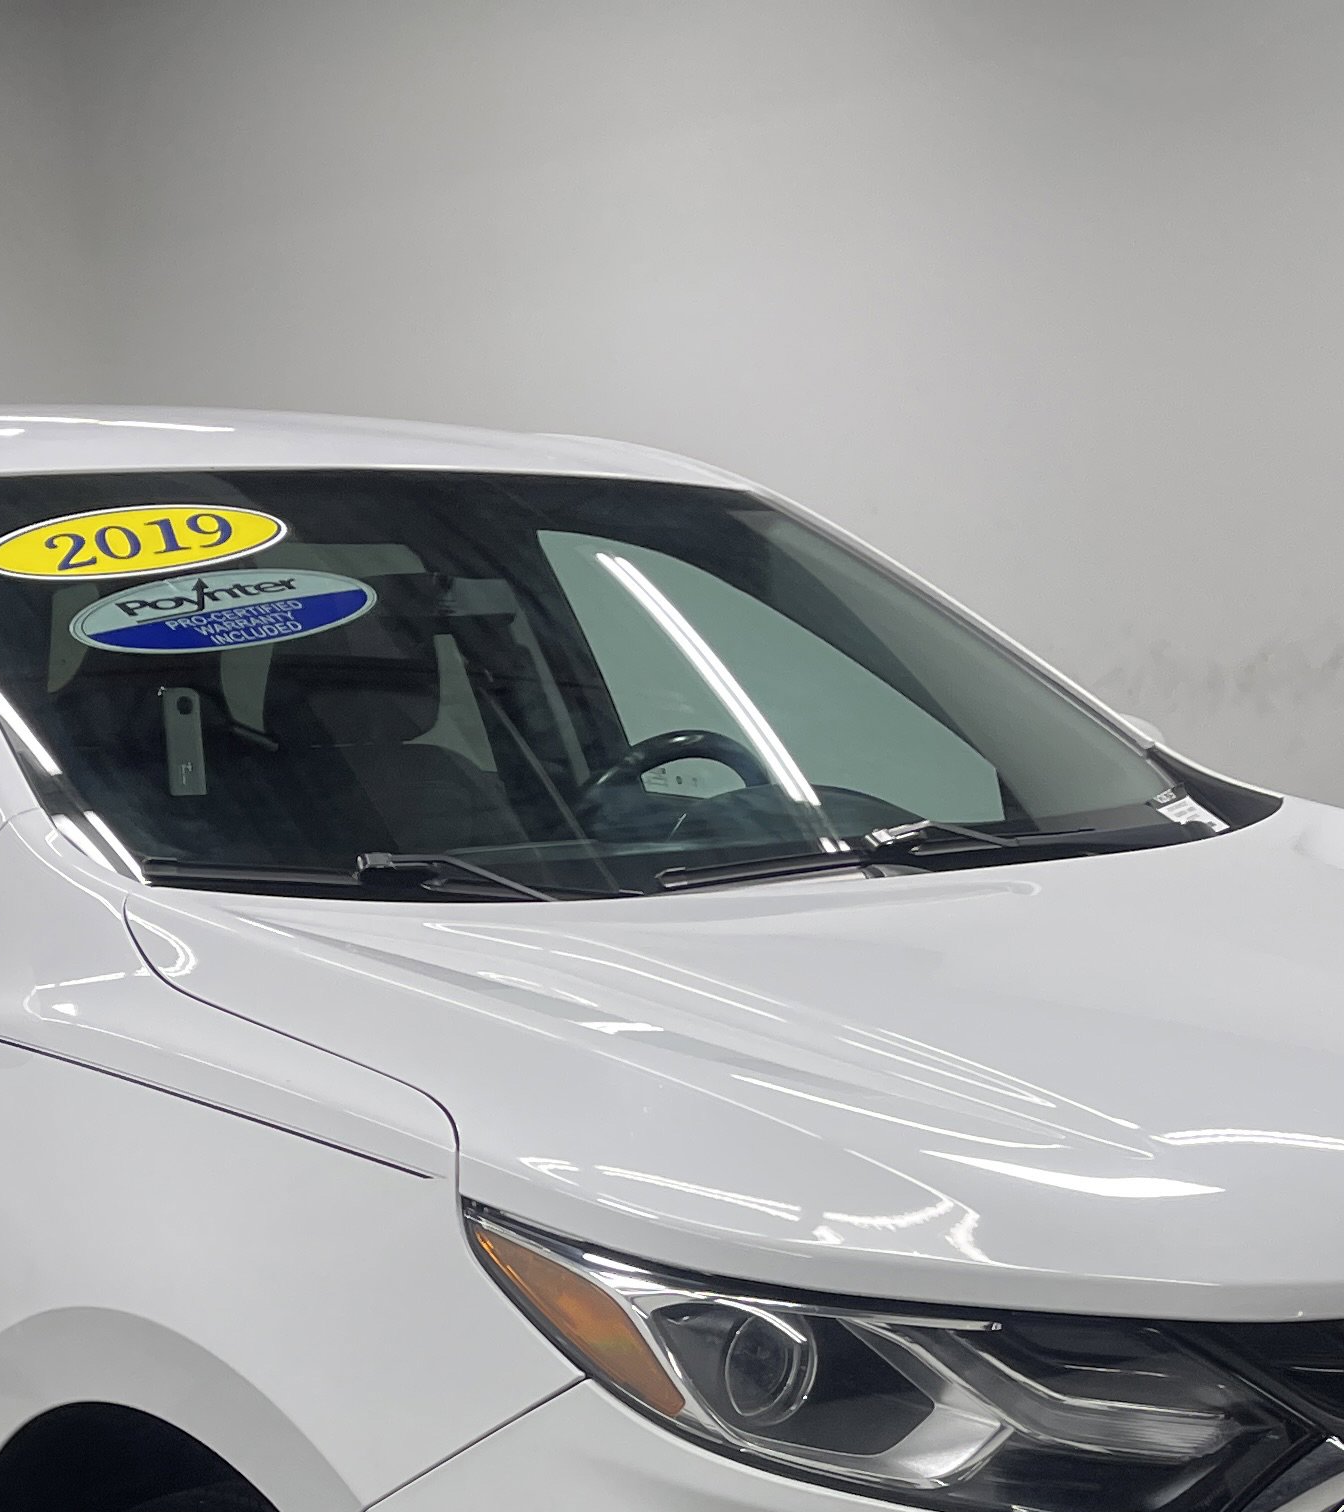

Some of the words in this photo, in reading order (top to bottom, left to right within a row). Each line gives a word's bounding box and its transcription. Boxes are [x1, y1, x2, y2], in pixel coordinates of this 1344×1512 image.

[44, 513, 233, 571] 2019
[115, 577, 296, 617] Poynter
[165, 599, 303, 631] PRO-CERTIFIED
[193, 611, 295, 636] WARRANTY
[210, 620, 303, 645] INCLUDED
